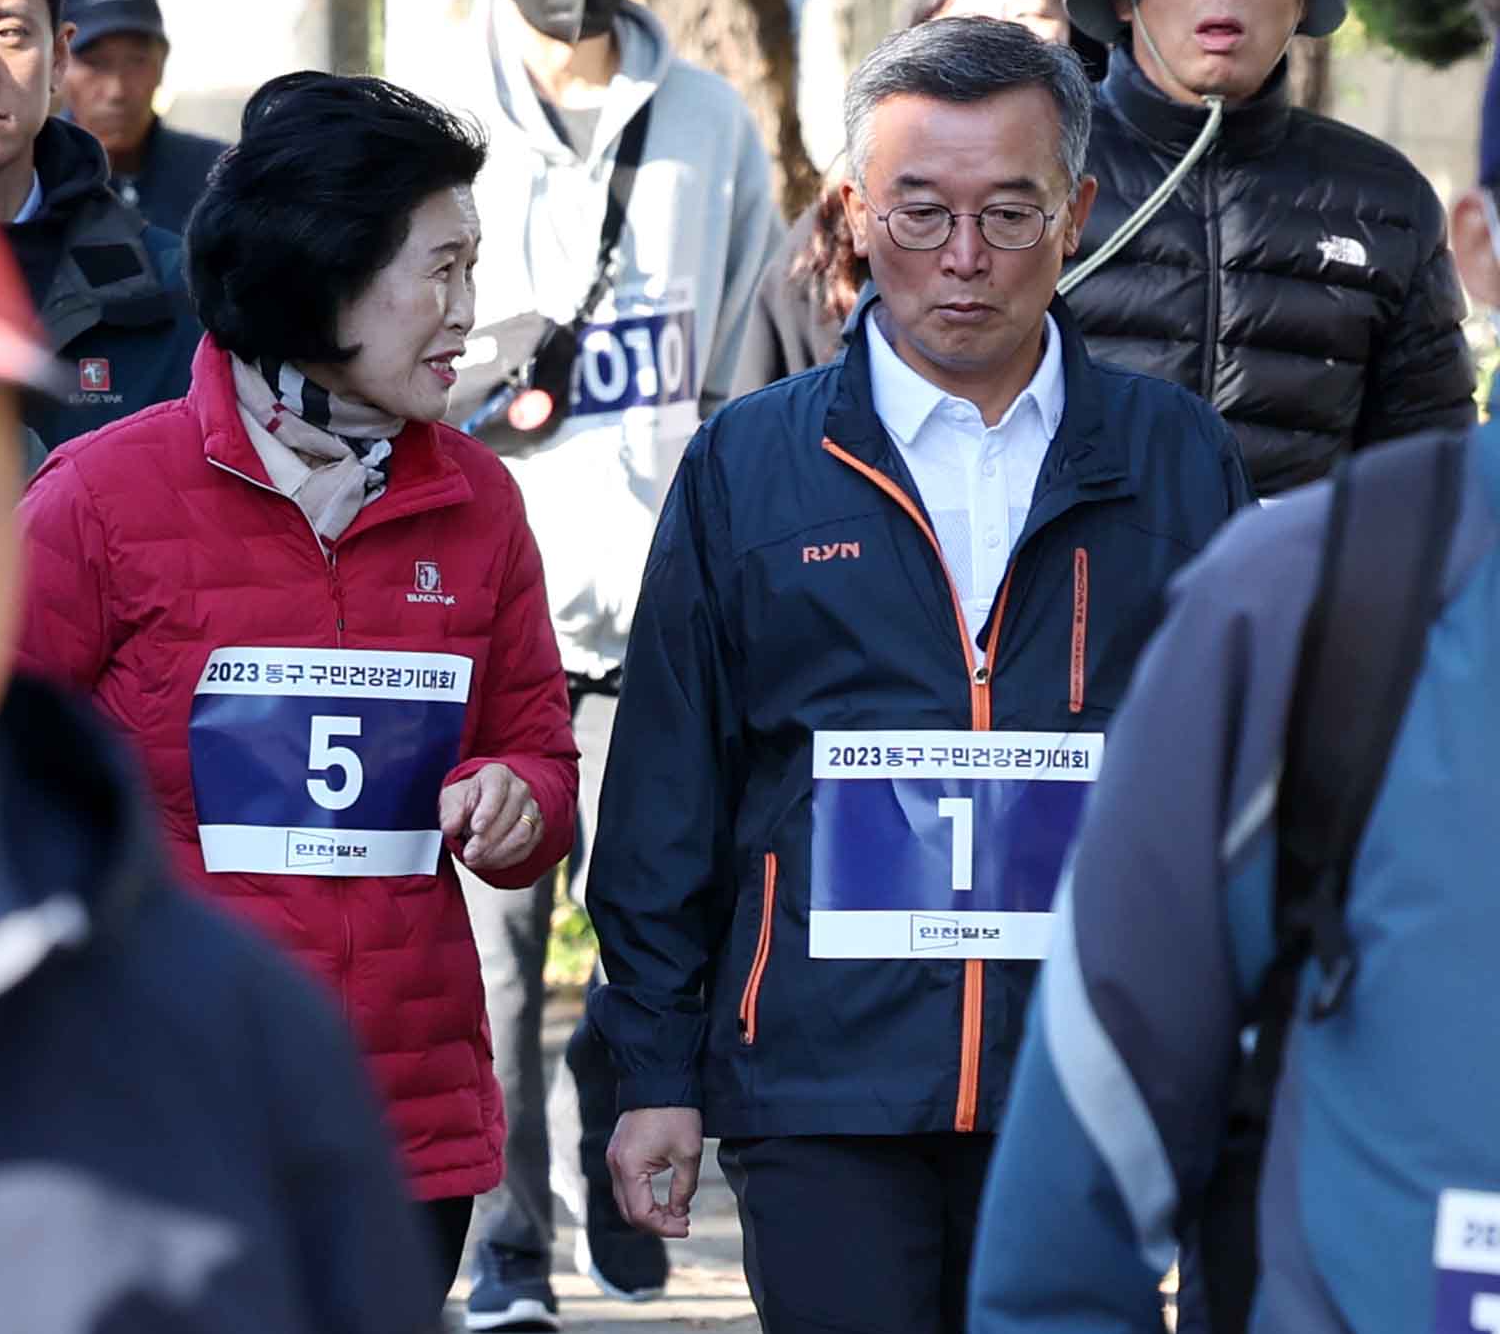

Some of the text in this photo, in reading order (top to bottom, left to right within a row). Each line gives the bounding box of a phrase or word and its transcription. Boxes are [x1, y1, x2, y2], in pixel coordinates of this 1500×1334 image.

[803, 542, 860, 563] RYN
[206, 661, 457, 690] 2023 동구 구민건강걷기대회
[306, 715, 363, 811] 5
[828, 747, 1090, 769] 2023 동구 구민건강걷기대회
[938, 797, 973, 891] 1
